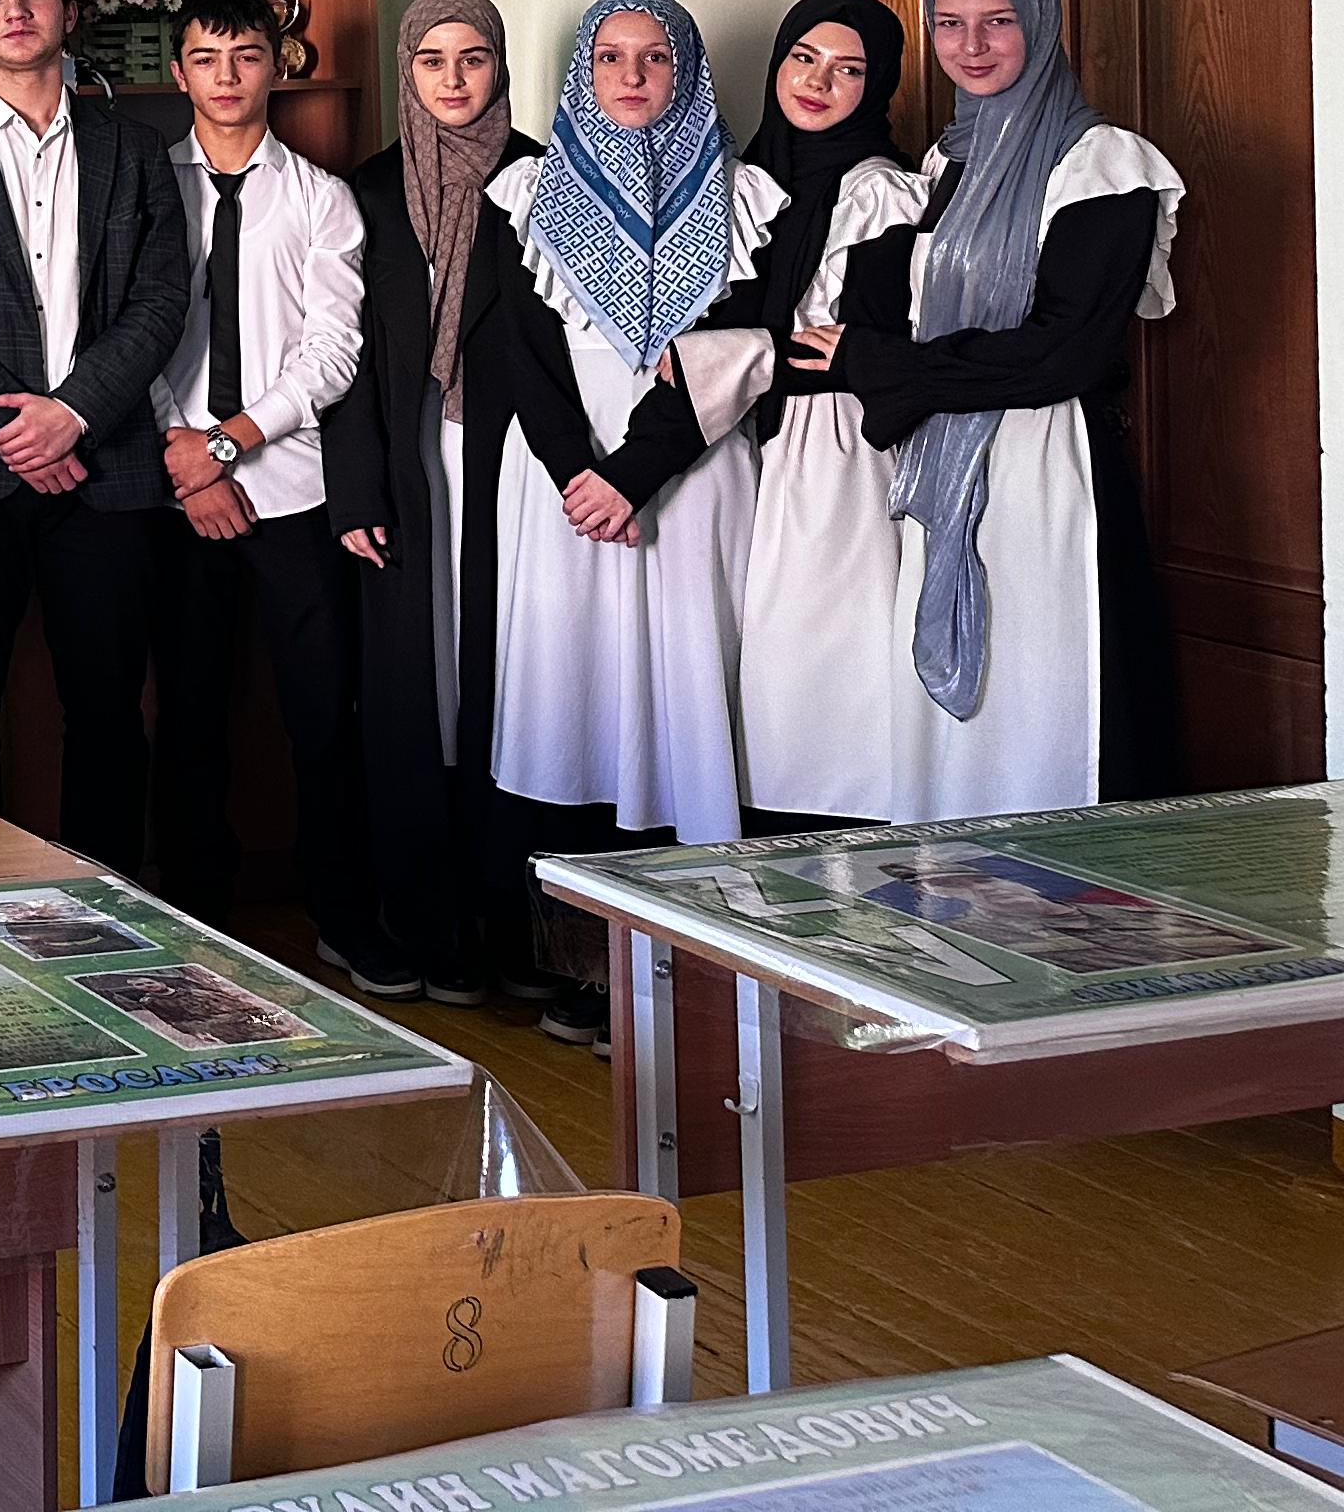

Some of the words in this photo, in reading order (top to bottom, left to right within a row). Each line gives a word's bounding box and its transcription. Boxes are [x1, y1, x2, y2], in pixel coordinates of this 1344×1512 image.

[6, 1054, 294, 1103] БРОСАЕМ!
[441, 1295, 485, 1373] 8
[482, 1392, 991, 1505] МАГОМЕДОВИЧ
